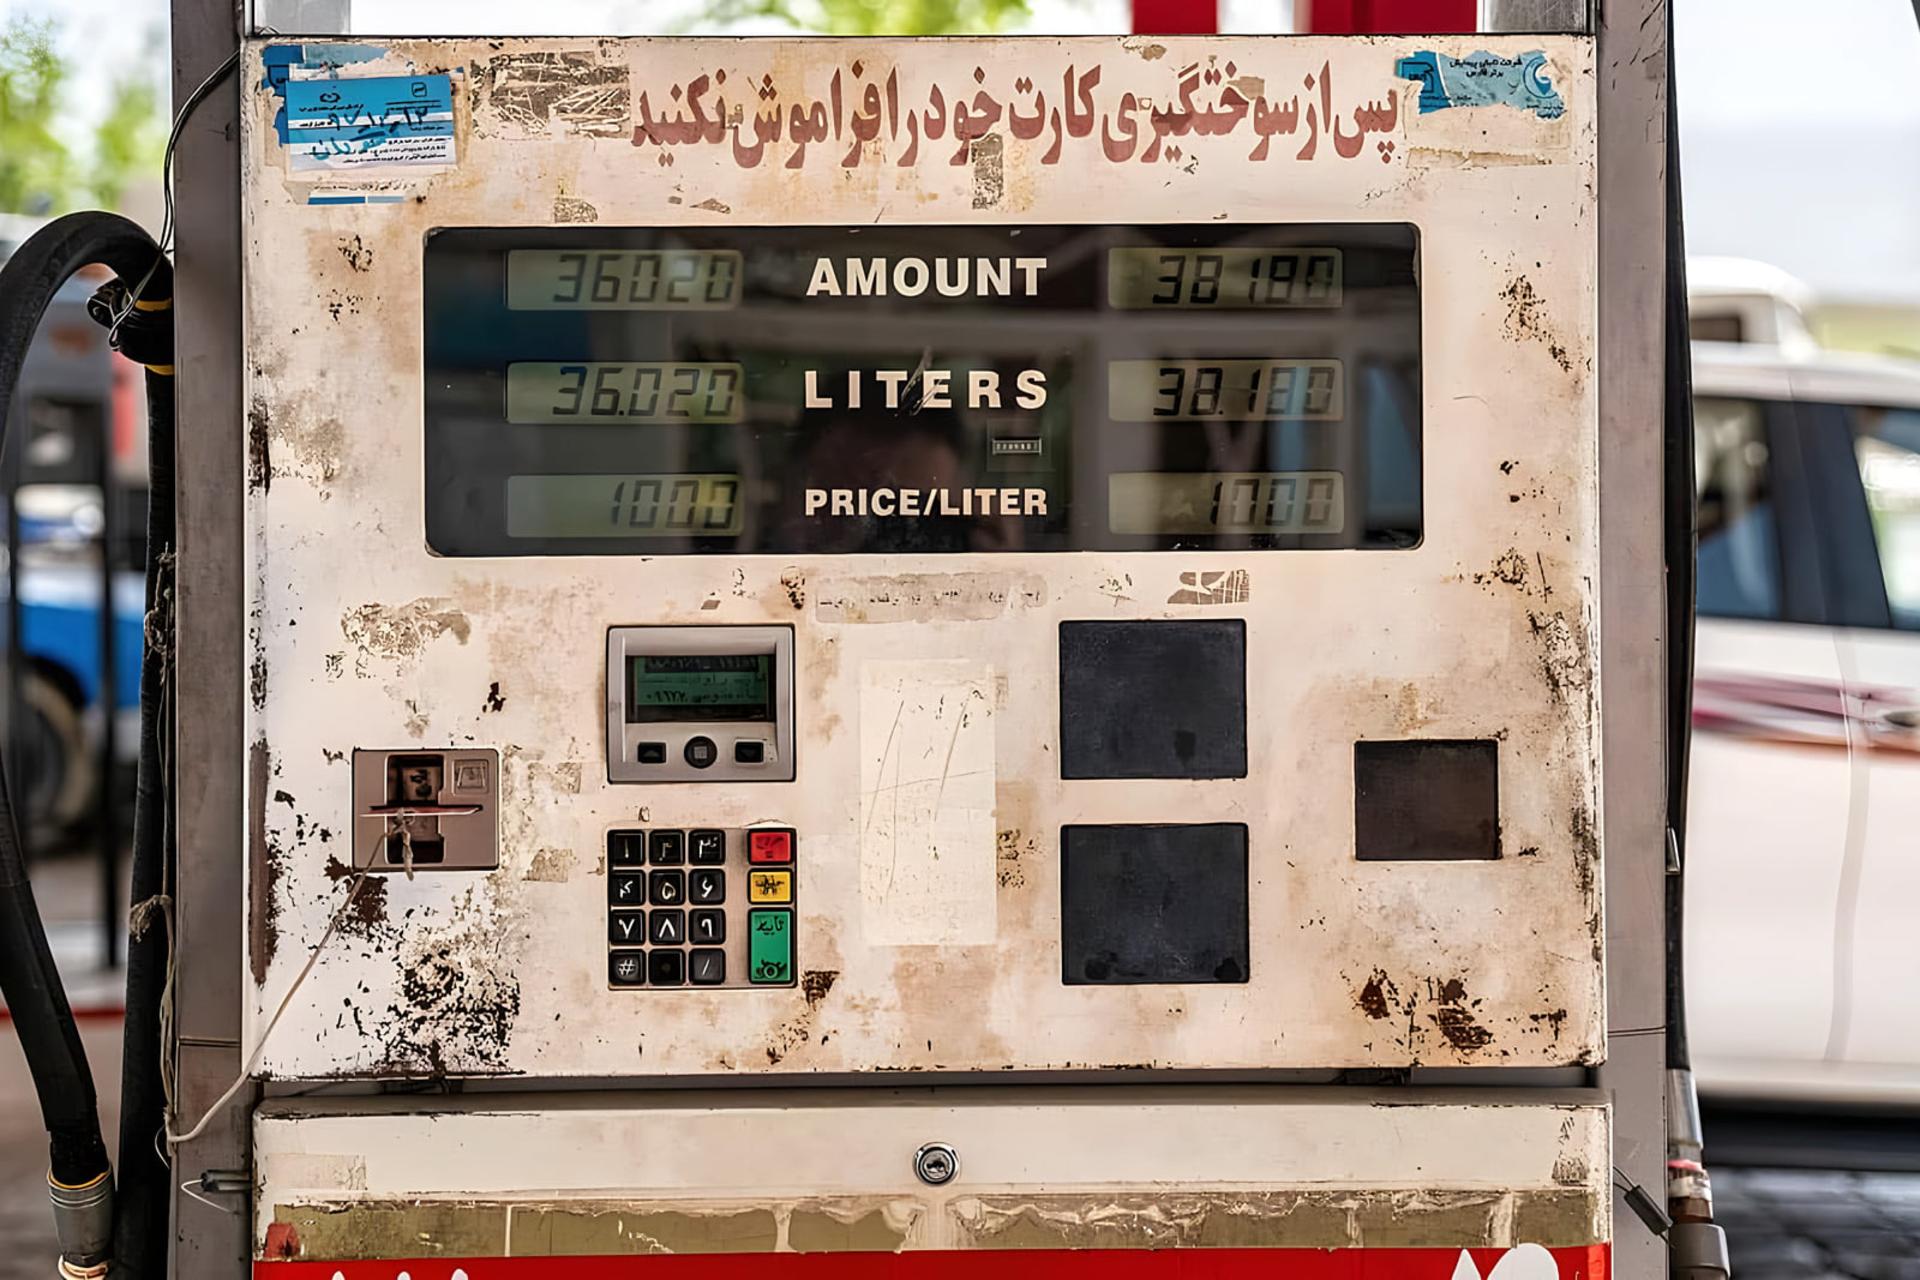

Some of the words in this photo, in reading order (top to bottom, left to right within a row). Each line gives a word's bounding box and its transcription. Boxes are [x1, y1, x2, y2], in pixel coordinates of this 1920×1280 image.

[632, 68, 727, 167] نکنید
[733, 60, 881, 169] فراموش
[887, 66, 918, 167] را
[924, 66, 1002, 166] خود
[1008, 63, 1101, 165] کارت
[1102, 60, 1298, 163] سوختگیری
[1296, 60, 1331, 161] از
[1333, 90, 1398, 164] پس
[553, 254, 738, 303] 36020
[806, 257, 1047, 297] AMOUNT
[553, 366, 738, 416] 36.020
[805, 369, 1047, 410] LITERS
[611, 480, 738, 529] 1000
[805, 488, 1047, 516] PRICE/LITER
[1210, 478, 1335, 527] 1000
[618, 918, 635, 939] ۷
[659, 918, 675, 938] ۸
[701, 918, 713, 937] ۹
